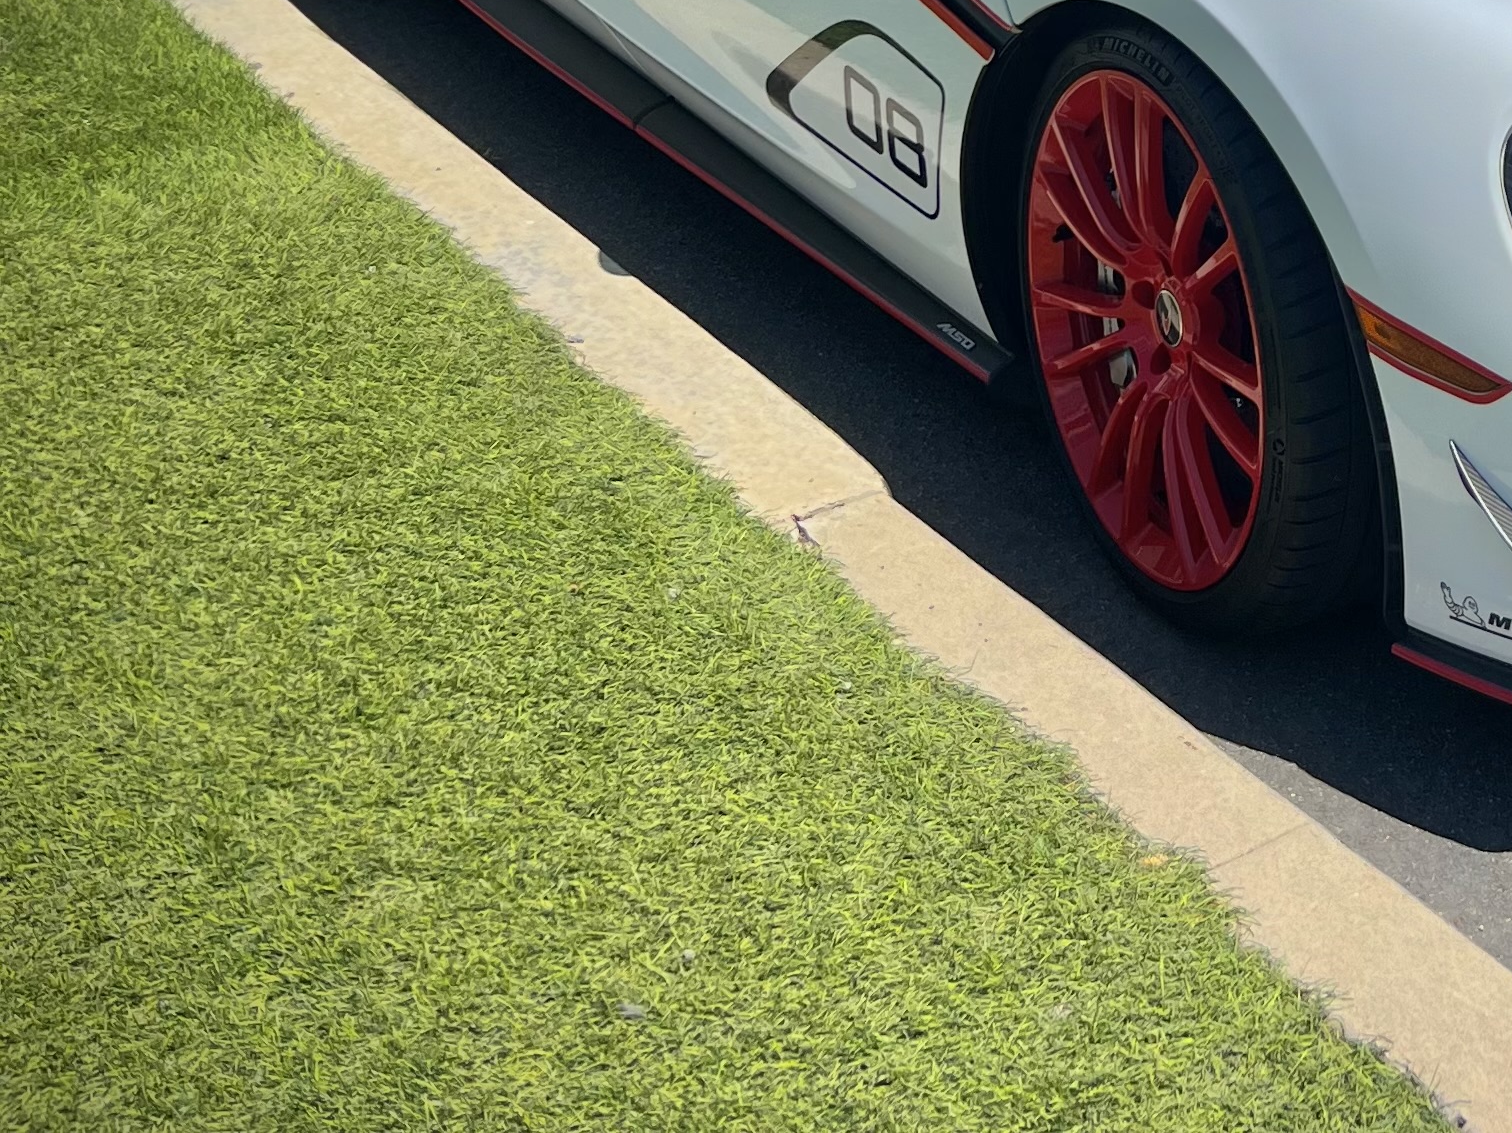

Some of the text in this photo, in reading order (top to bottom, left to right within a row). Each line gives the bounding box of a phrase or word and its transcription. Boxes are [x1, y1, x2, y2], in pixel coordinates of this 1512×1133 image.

[1103, 36, 1171, 83] MICHELIN
[844, 65, 928, 188] 08
[936, 323, 976, 351] MSO
